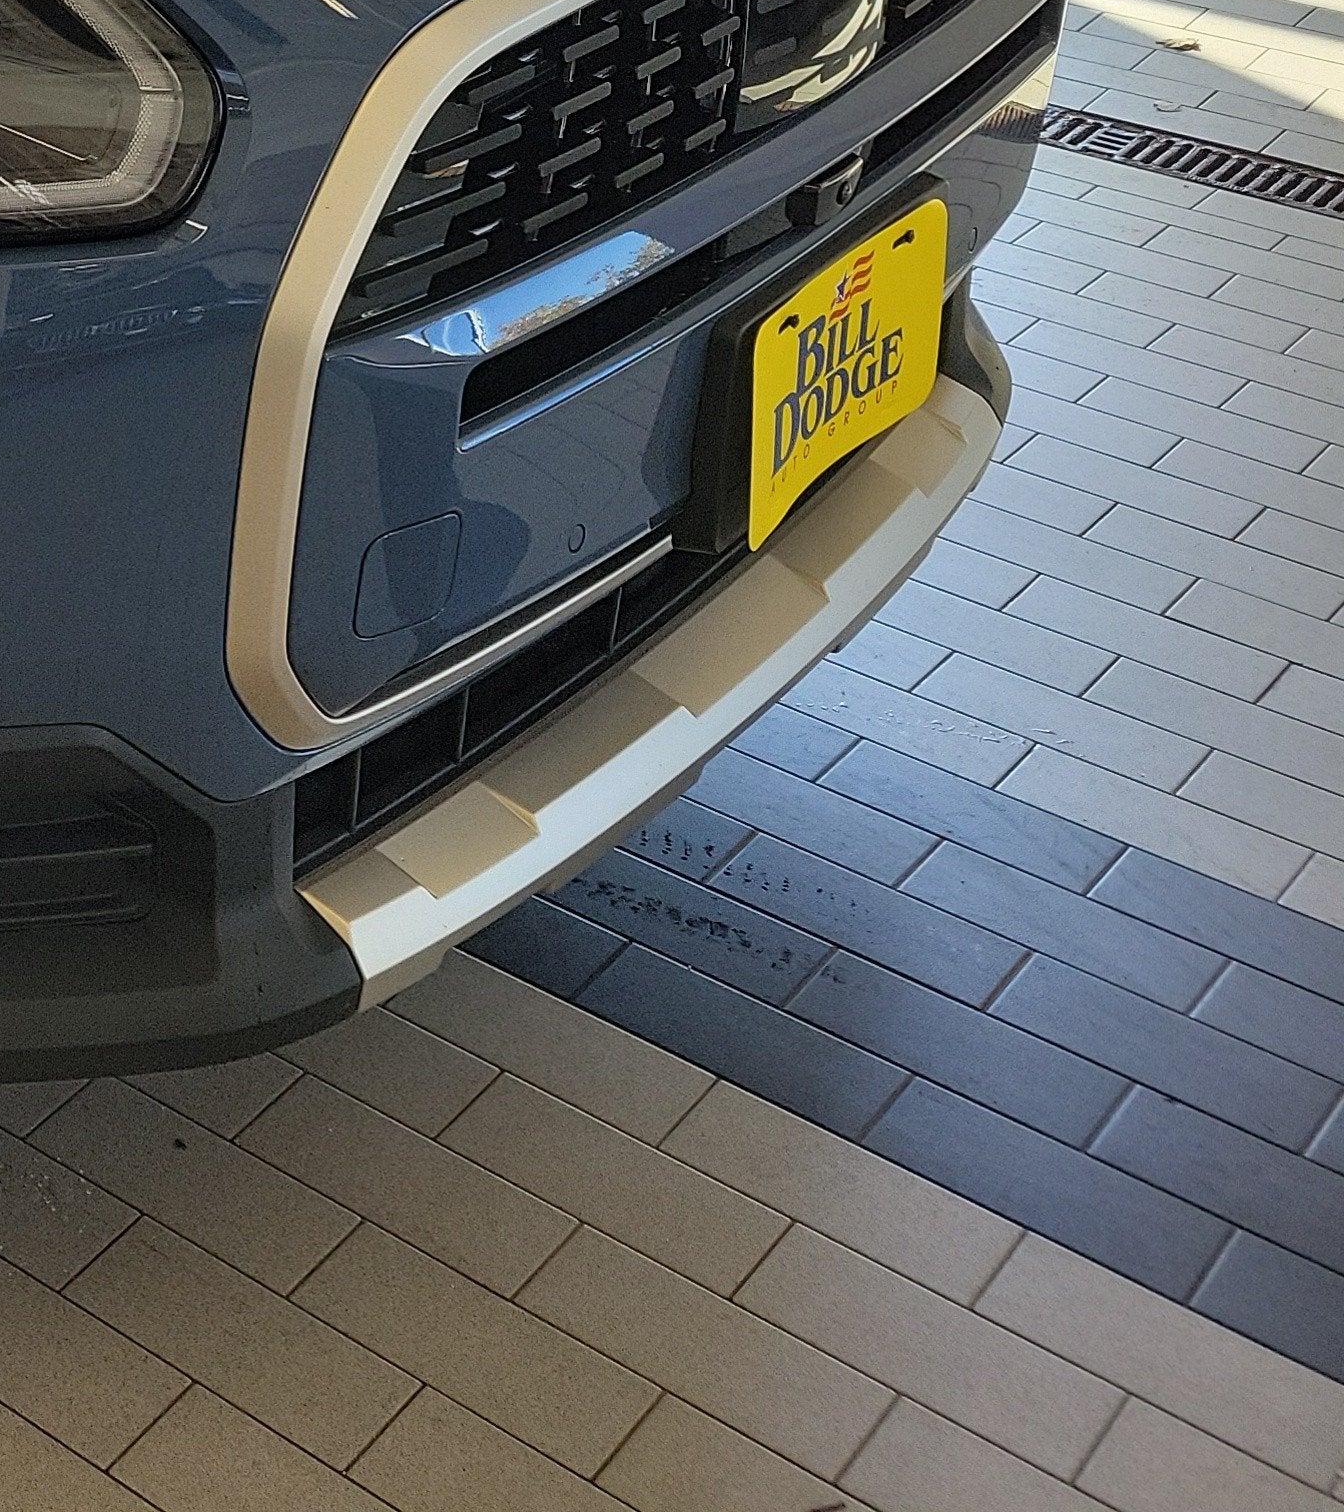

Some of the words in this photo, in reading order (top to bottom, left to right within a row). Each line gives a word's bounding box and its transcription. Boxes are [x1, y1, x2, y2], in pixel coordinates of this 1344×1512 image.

[772, 327, 904, 478] DODGE
[796, 298, 880, 398] BILL
[770, 443, 810, 493] AUTO
[827, 380, 898, 437] GROUP
